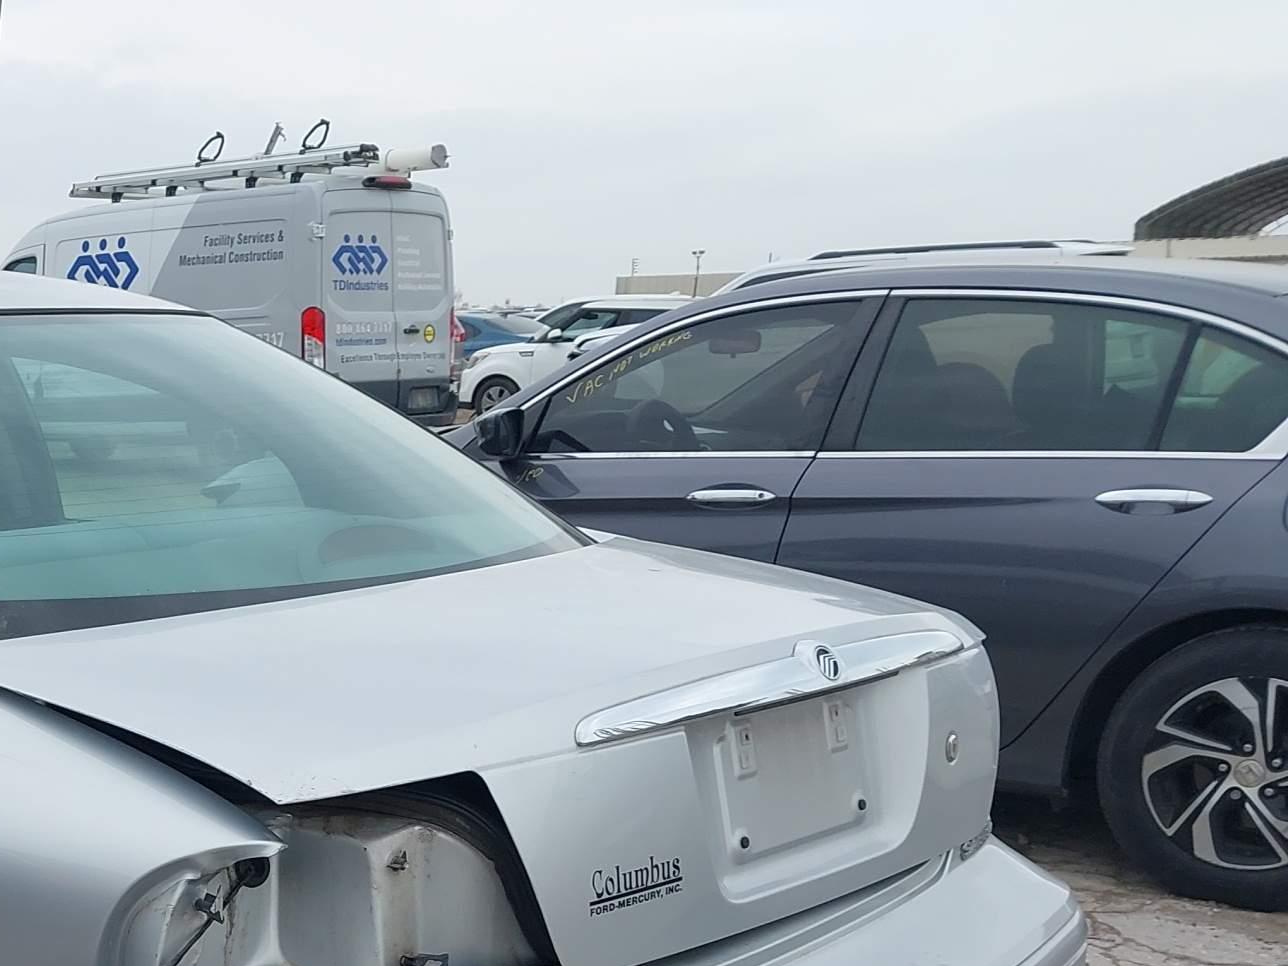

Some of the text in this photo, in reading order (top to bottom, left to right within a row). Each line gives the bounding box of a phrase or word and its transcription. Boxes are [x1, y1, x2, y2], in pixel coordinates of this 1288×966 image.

[203, 229, 285, 248] Facility Services &
[178, 249, 285, 267] Mechanical Construction
[332, 279, 390, 291] TDIndustries
[591, 855, 681, 899] Columbus
[589, 883, 684, 918] FORD-MERCURY, INC.
